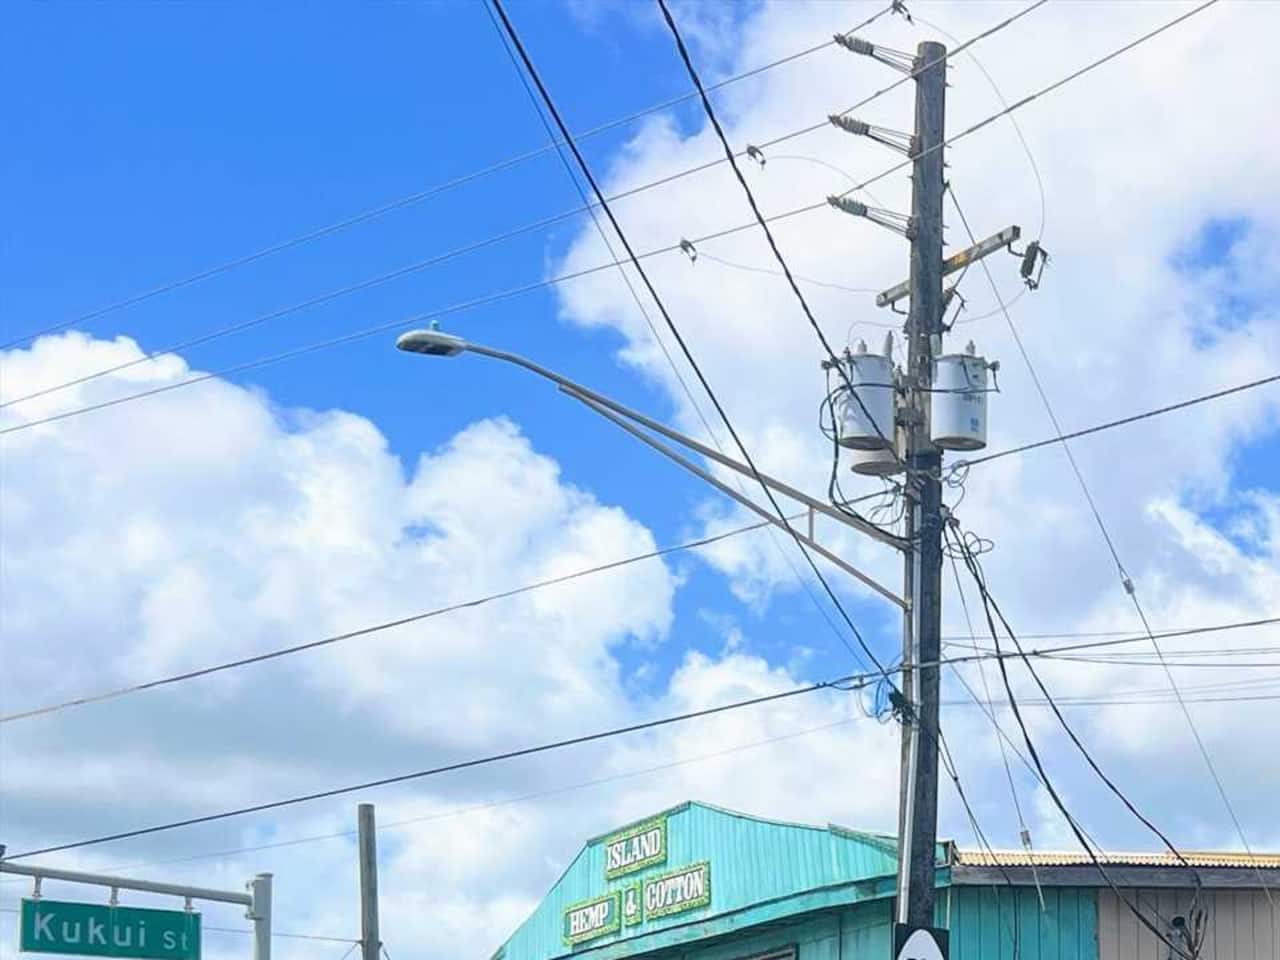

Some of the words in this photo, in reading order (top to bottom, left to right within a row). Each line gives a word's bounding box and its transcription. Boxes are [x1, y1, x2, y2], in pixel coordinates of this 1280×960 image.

[607, 828, 661, 868] ISLAND
[570, 901, 609, 937] HEMP
[625, 889, 637, 915] &
[647, 869, 705, 911] COTTON
[33, 912, 147, 949] Kukui
[163, 930, 189, 951] St
